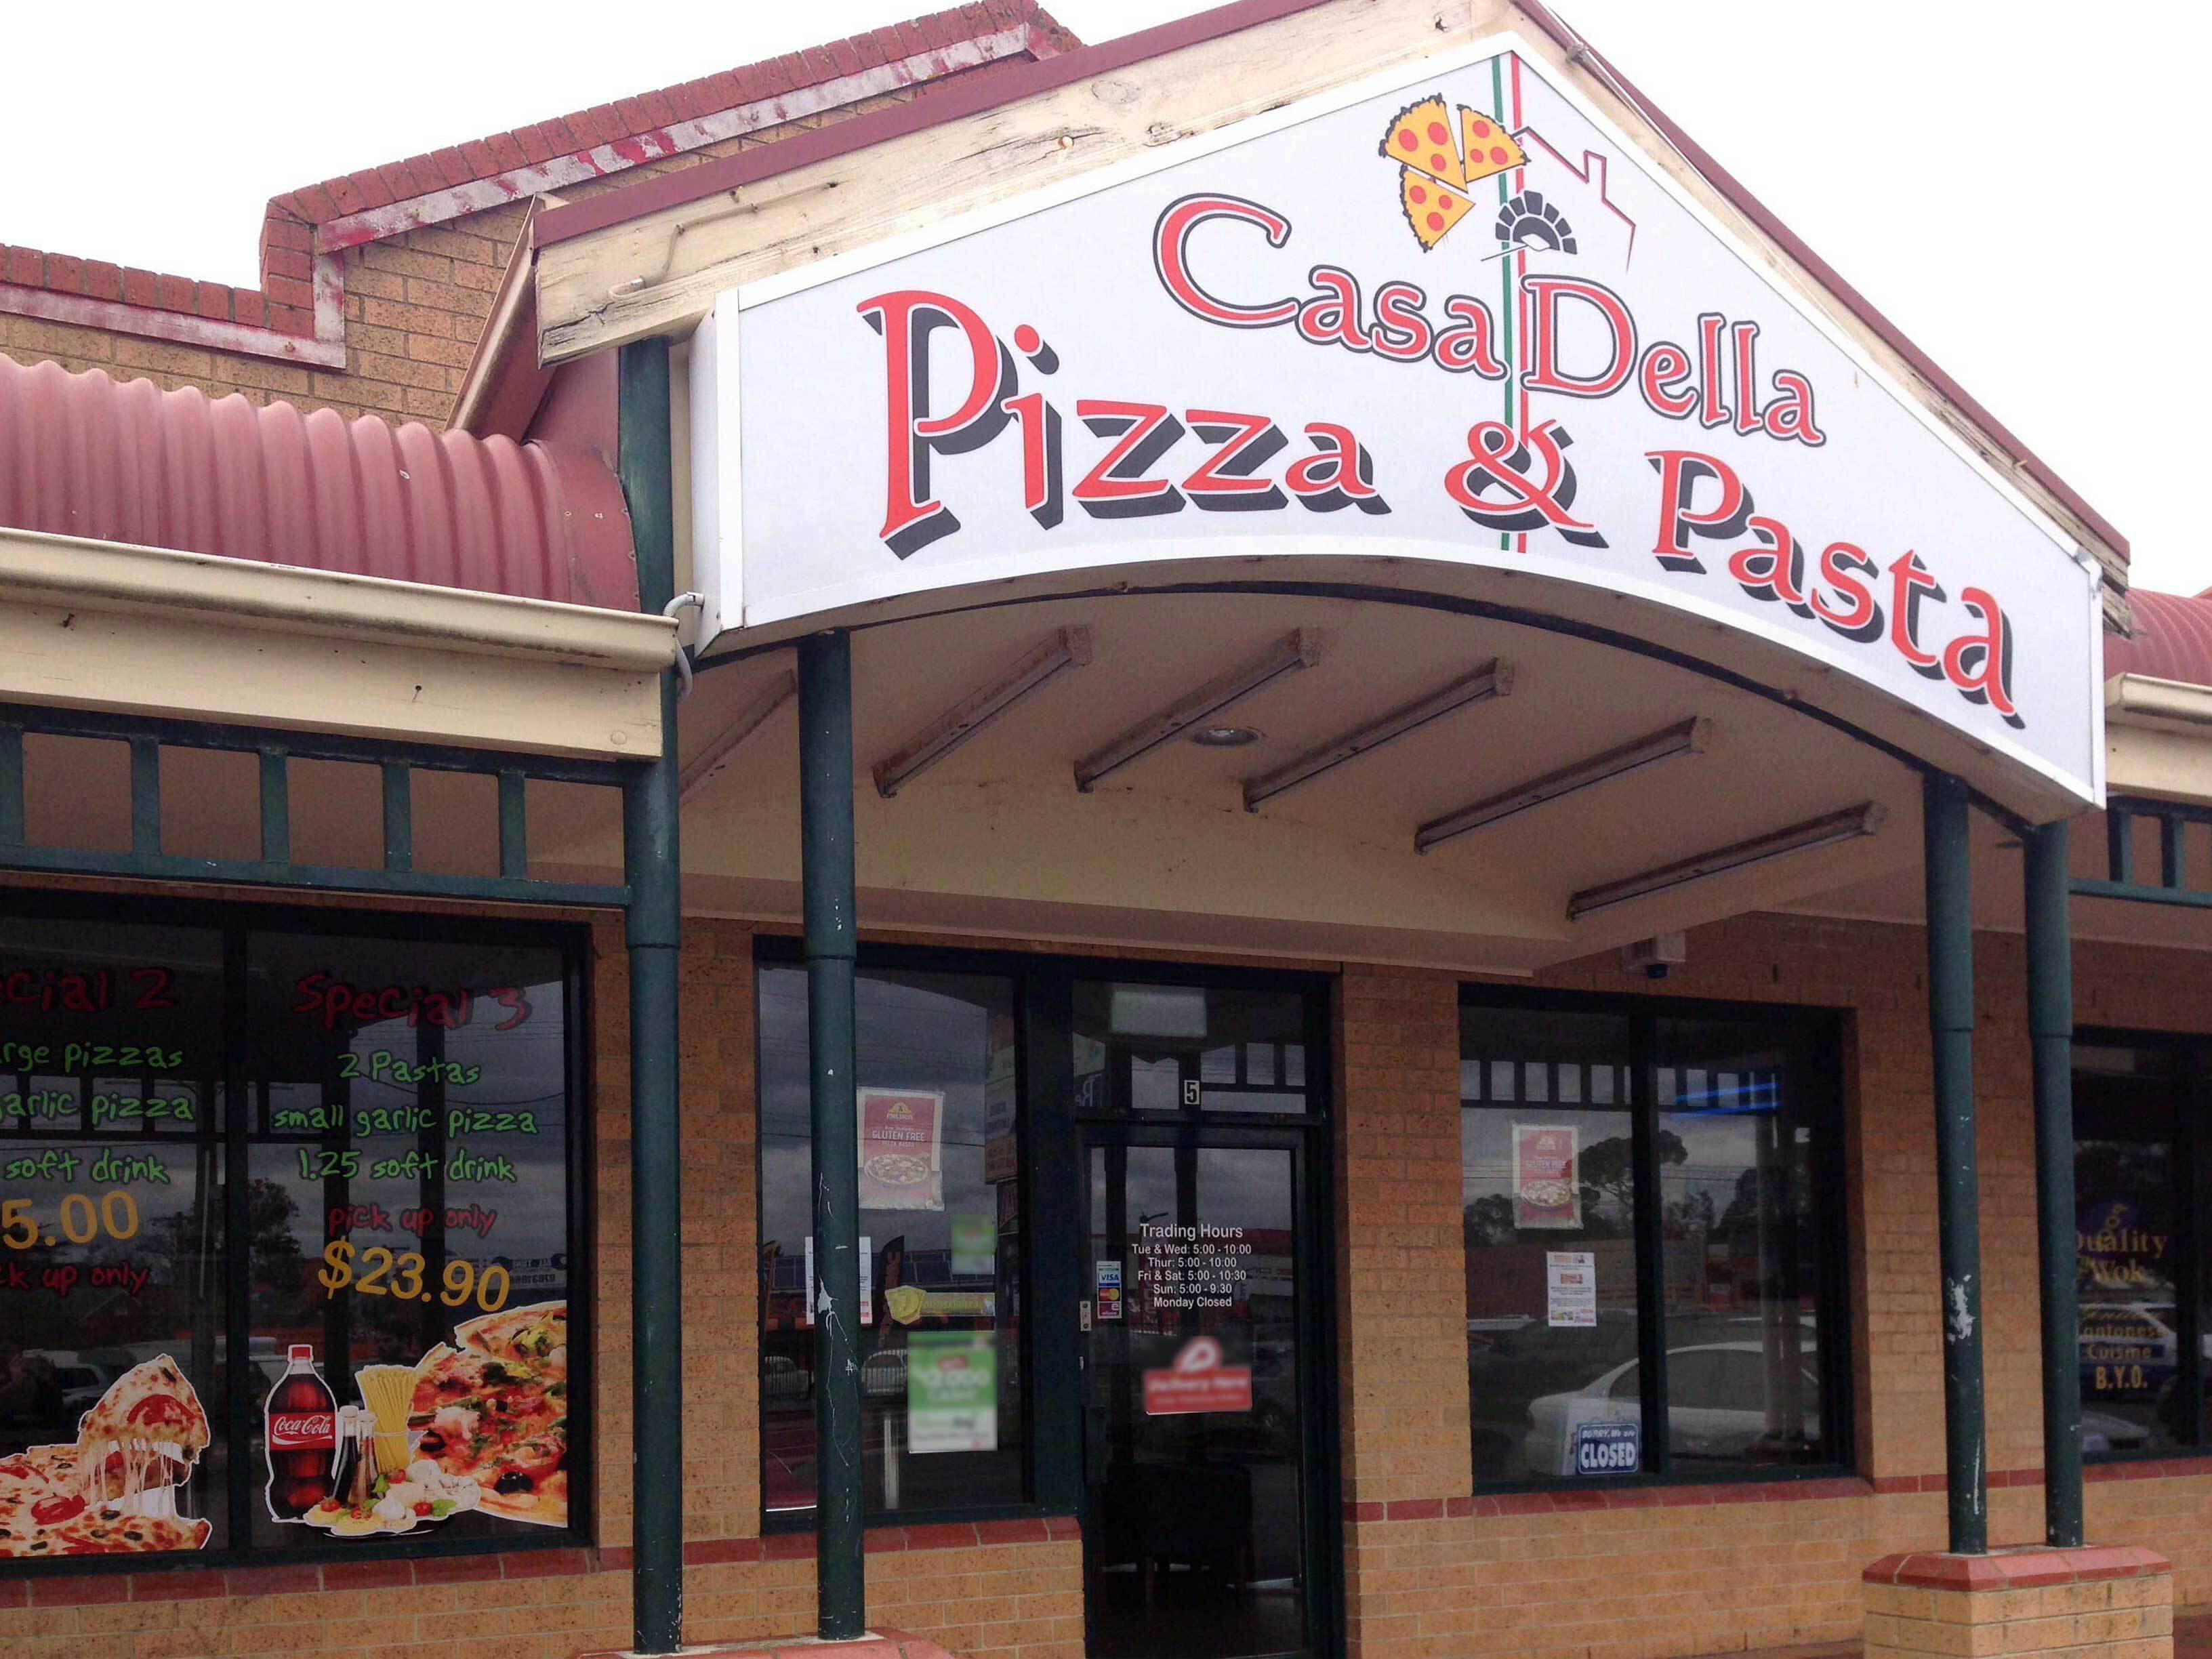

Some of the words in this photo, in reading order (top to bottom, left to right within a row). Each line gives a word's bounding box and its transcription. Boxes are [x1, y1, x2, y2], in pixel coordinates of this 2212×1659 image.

[1153, 192, 1509, 381] Casa
[1521, 274, 1828, 447] Della
[856, 290, 1392, 560] Pizza
[1445, 419, 1610, 549] &
[1645, 449, 2026, 730] Pasta
[0, 970, 106, 1012] cial
[129, 969, 175, 1010] 2
[293, 972, 468, 1032] Special
[489, 987, 533, 1031] 3
[0, 1040, 50, 1071] rge
[64, 1042, 184, 1073] pizzas
[337, 1053, 361, 1079] 2
[371, 1050, 481, 1084] Pastas
[0, 1090, 79, 1120] arlic
[91, 1093, 194, 1126] pizza
[1186, 1082, 1197, 1103] 5
[274, 1105, 344, 1129] small
[355, 1105, 437, 1137] garlic
[449, 1109, 539, 1139] pizza
[872, 1130, 903, 1140] GLUTEN
[907, 1132, 926, 1142] FREE
[5, 1151, 80, 1181] soft
[91, 1148, 171, 1183] drink
[298, 1149, 361, 1181] 1.25
[369, 1152, 439, 1181] soft
[449, 1149, 517, 1183] drink
[328, 1204, 394, 1236] pick
[401, 1206, 435, 1235] up
[444, 1204, 499, 1237] only
[1140, 1223, 1196, 1241] Trading
[1201, 1224, 1243, 1238] Hours
[1132, 1244, 1151, 1254] Tue
[1154, 1245, 1162, 1254] &
[1164, 1244, 1190, 1254] Wed:
[1193, 1245, 1215, 1254] 5:00
[1224, 1244, 1252, 1254] 10:00
[1148, 1257, 1175, 1267] Thur:
[1178, 1258, 1200, 1267] 5:00
[1209, 1258, 1237, 1267] 10:00
[42, 1265, 79, 1297] up
[91, 1262, 152, 1299] only
[319, 1235, 511, 1313] $23.90
[1139, 1271, 1151, 1281] Fri
[1155, 1271, 1163, 1281] &
[1165, 1271, 1185, 1281] Sat:
[1188, 1271, 1210, 1281] 5:00
[1219, 1271, 1246, 1281] 10:30
[2092, 1259, 2146, 1284] Wok
[1153, 1284, 1176, 1294] Sun:
[1179, 1284, 1202, 1294] 5:00
[1153, 1297, 1194, 1309] Monday
[1197, 1297, 1233, 1307] Closed
[2095, 1365, 2148, 1389] B.Y.O.
[1581, 1442, 1636, 1469] CLOSED
